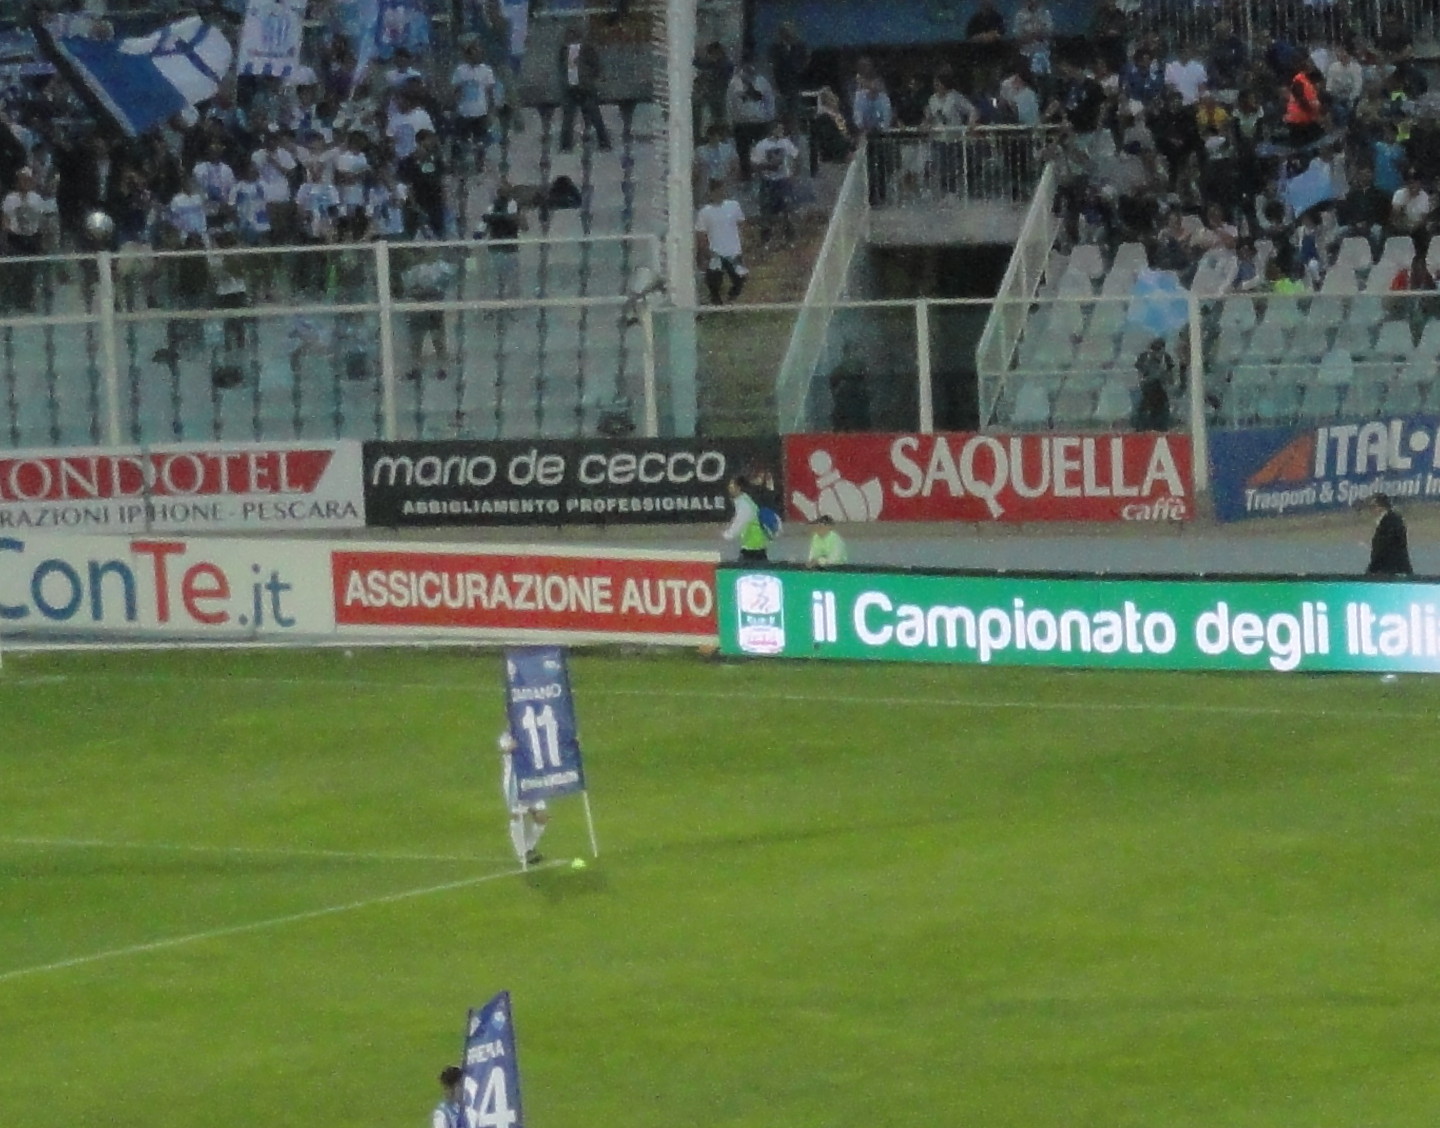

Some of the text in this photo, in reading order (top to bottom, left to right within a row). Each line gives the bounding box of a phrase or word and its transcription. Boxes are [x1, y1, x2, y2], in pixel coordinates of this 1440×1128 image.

[508, 449, 565, 486] de
[578, 451, 726, 485] cecco
[890, 435, 1186, 519] SAQUELLA
[242, 498, 359, 521] PESCARA
[403, 496, 726, 515] ABBIGLIAMENTO PROFESSIONALE
[1121, 497, 1187, 522] caffè
[1319, 481, 1335, 504] &
[346, 569, 713, 618] ASSICURAZIONE AUTO
[812, 590, 838, 644] il
[853, 591, 1177, 663] Campionato
[1196, 600, 1330, 671] degli
[522, 703, 562, 770] 11
